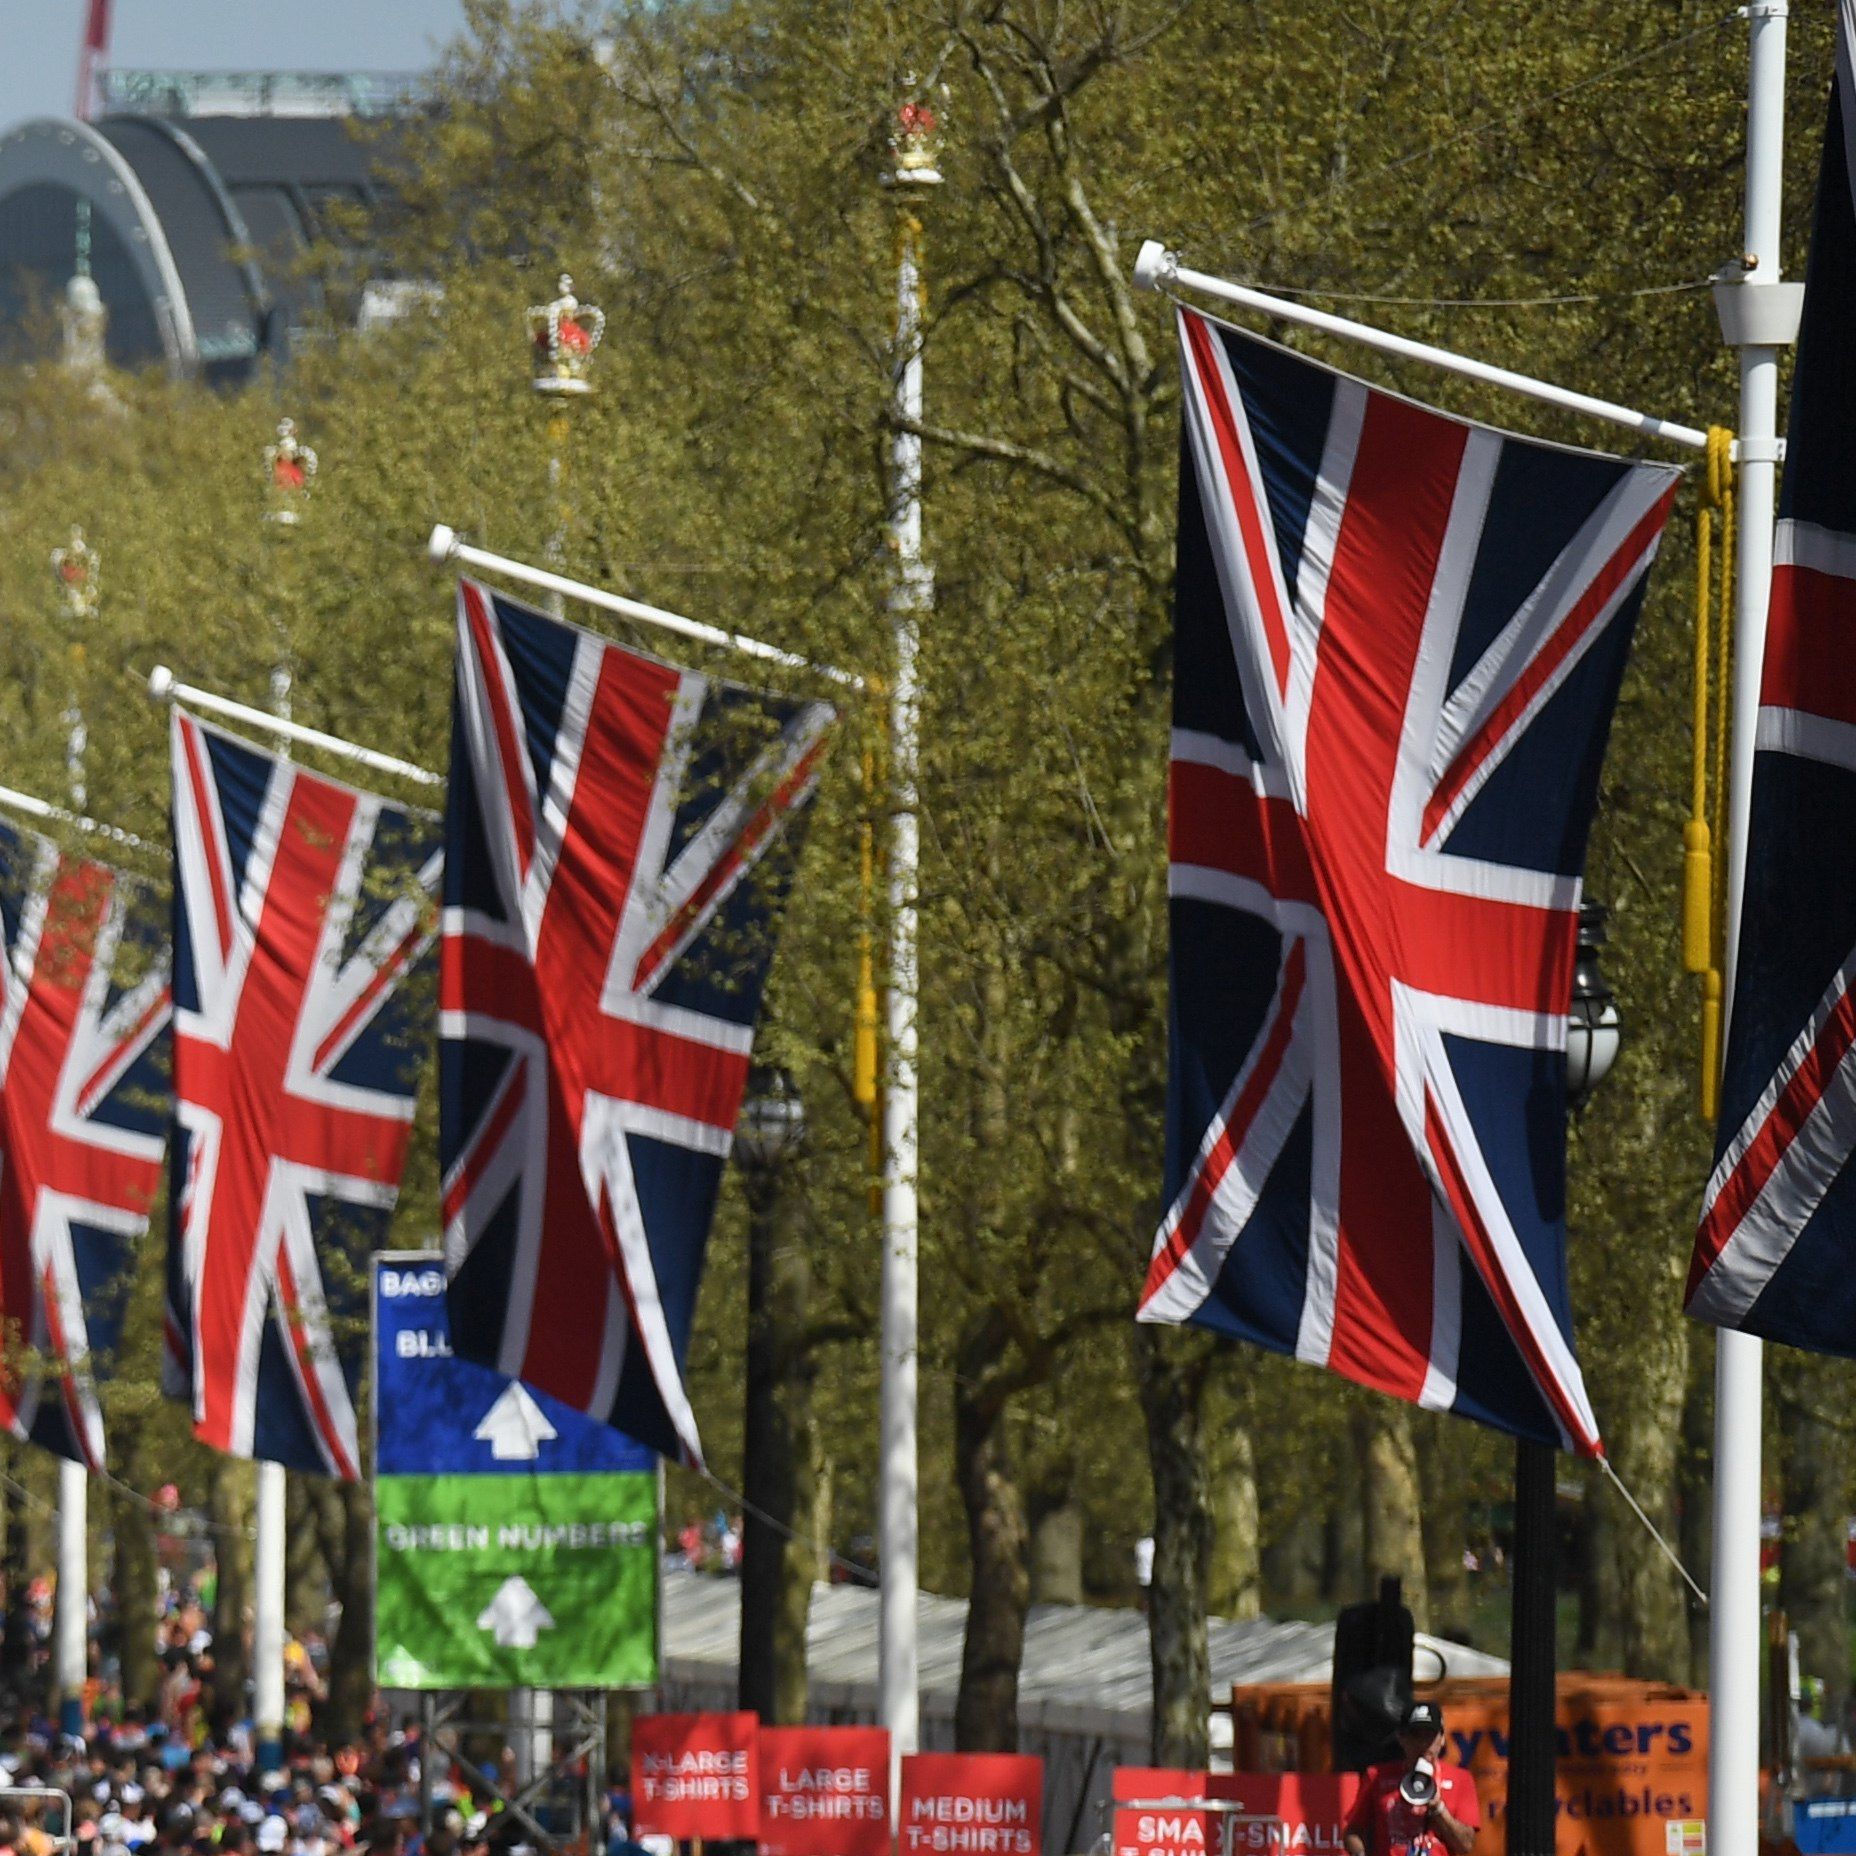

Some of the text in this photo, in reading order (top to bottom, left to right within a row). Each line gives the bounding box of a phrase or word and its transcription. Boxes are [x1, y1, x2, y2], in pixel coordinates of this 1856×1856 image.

[388, 1521, 649, 1552] GREEN NUMBERS
[642, 1750, 749, 1775] X-LARGE
[642, 1777, 750, 1801] T-SHIRTS
[779, 1768, 871, 1792] LARGE
[767, 1795, 886, 1820] T-SHIRTS
[912, 1796, 1027, 1824] MEDIUM
[907, 1826, 1032, 1854] T-SHIRTS
[1137, 1816, 1205, 1845] SMA
